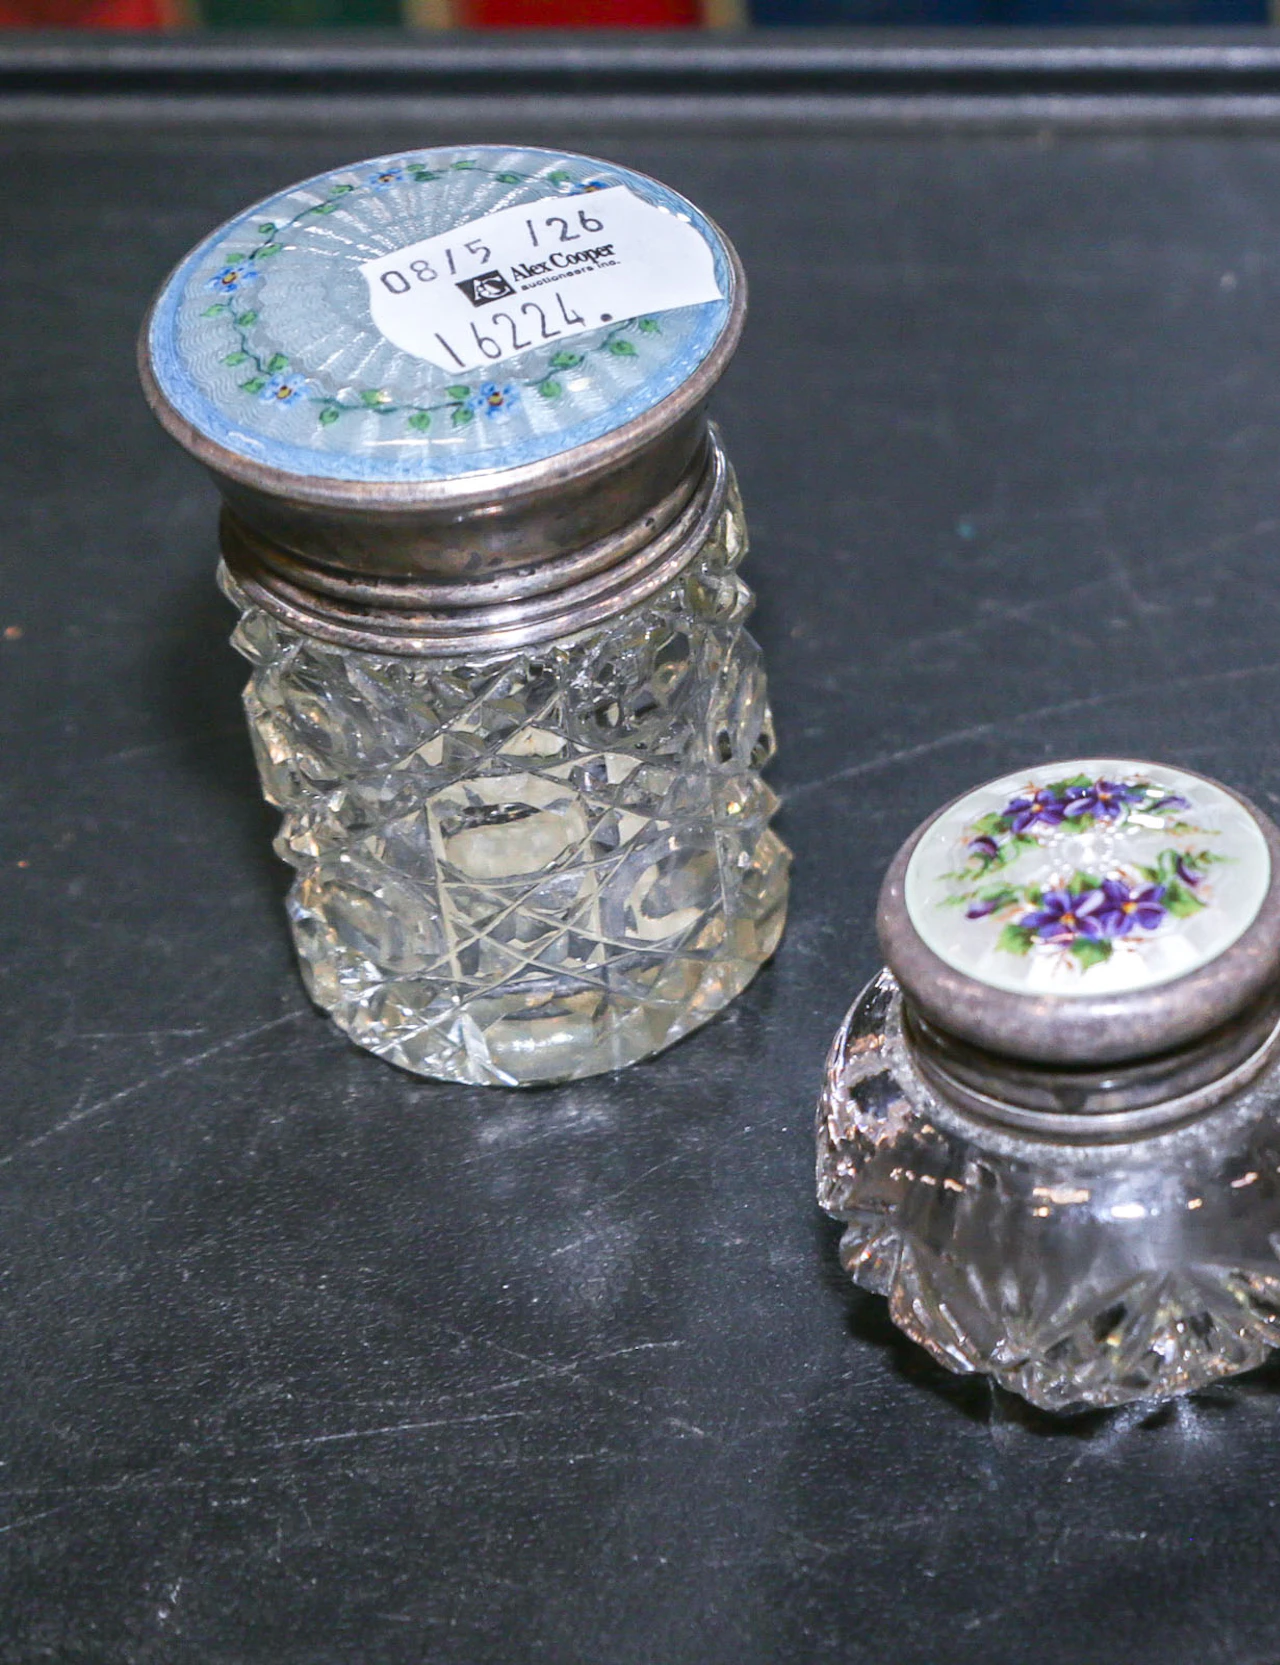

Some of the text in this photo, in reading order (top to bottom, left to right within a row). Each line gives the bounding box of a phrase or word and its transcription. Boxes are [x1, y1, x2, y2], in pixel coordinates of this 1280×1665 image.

[512, 243, 614, 282] Alex Cooper
[520, 266, 595, 291] auctioneers
